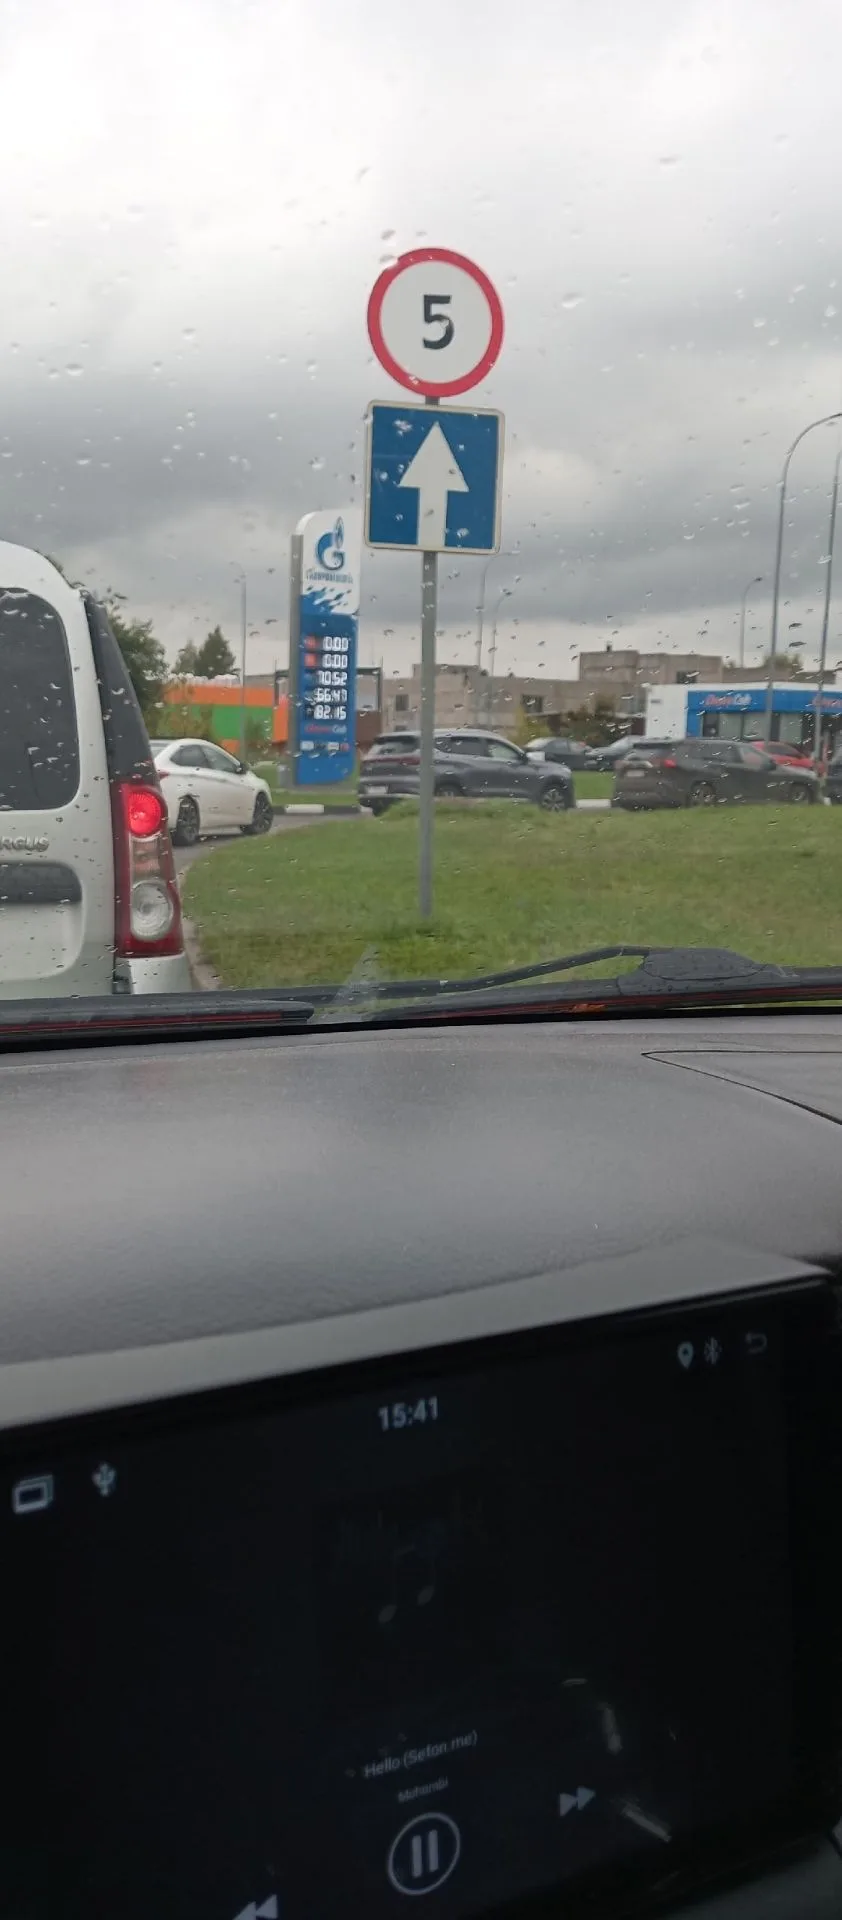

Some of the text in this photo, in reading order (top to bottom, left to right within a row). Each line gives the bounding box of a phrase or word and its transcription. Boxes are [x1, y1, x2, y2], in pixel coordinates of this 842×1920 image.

[422, 294, 455, 350] 5
[316, 670, 348, 687] 70.52
[313, 704, 347, 721] 82.15
[378, 1395, 438, 1432] 15:41
[363, 1755, 401, 1779] Hello
